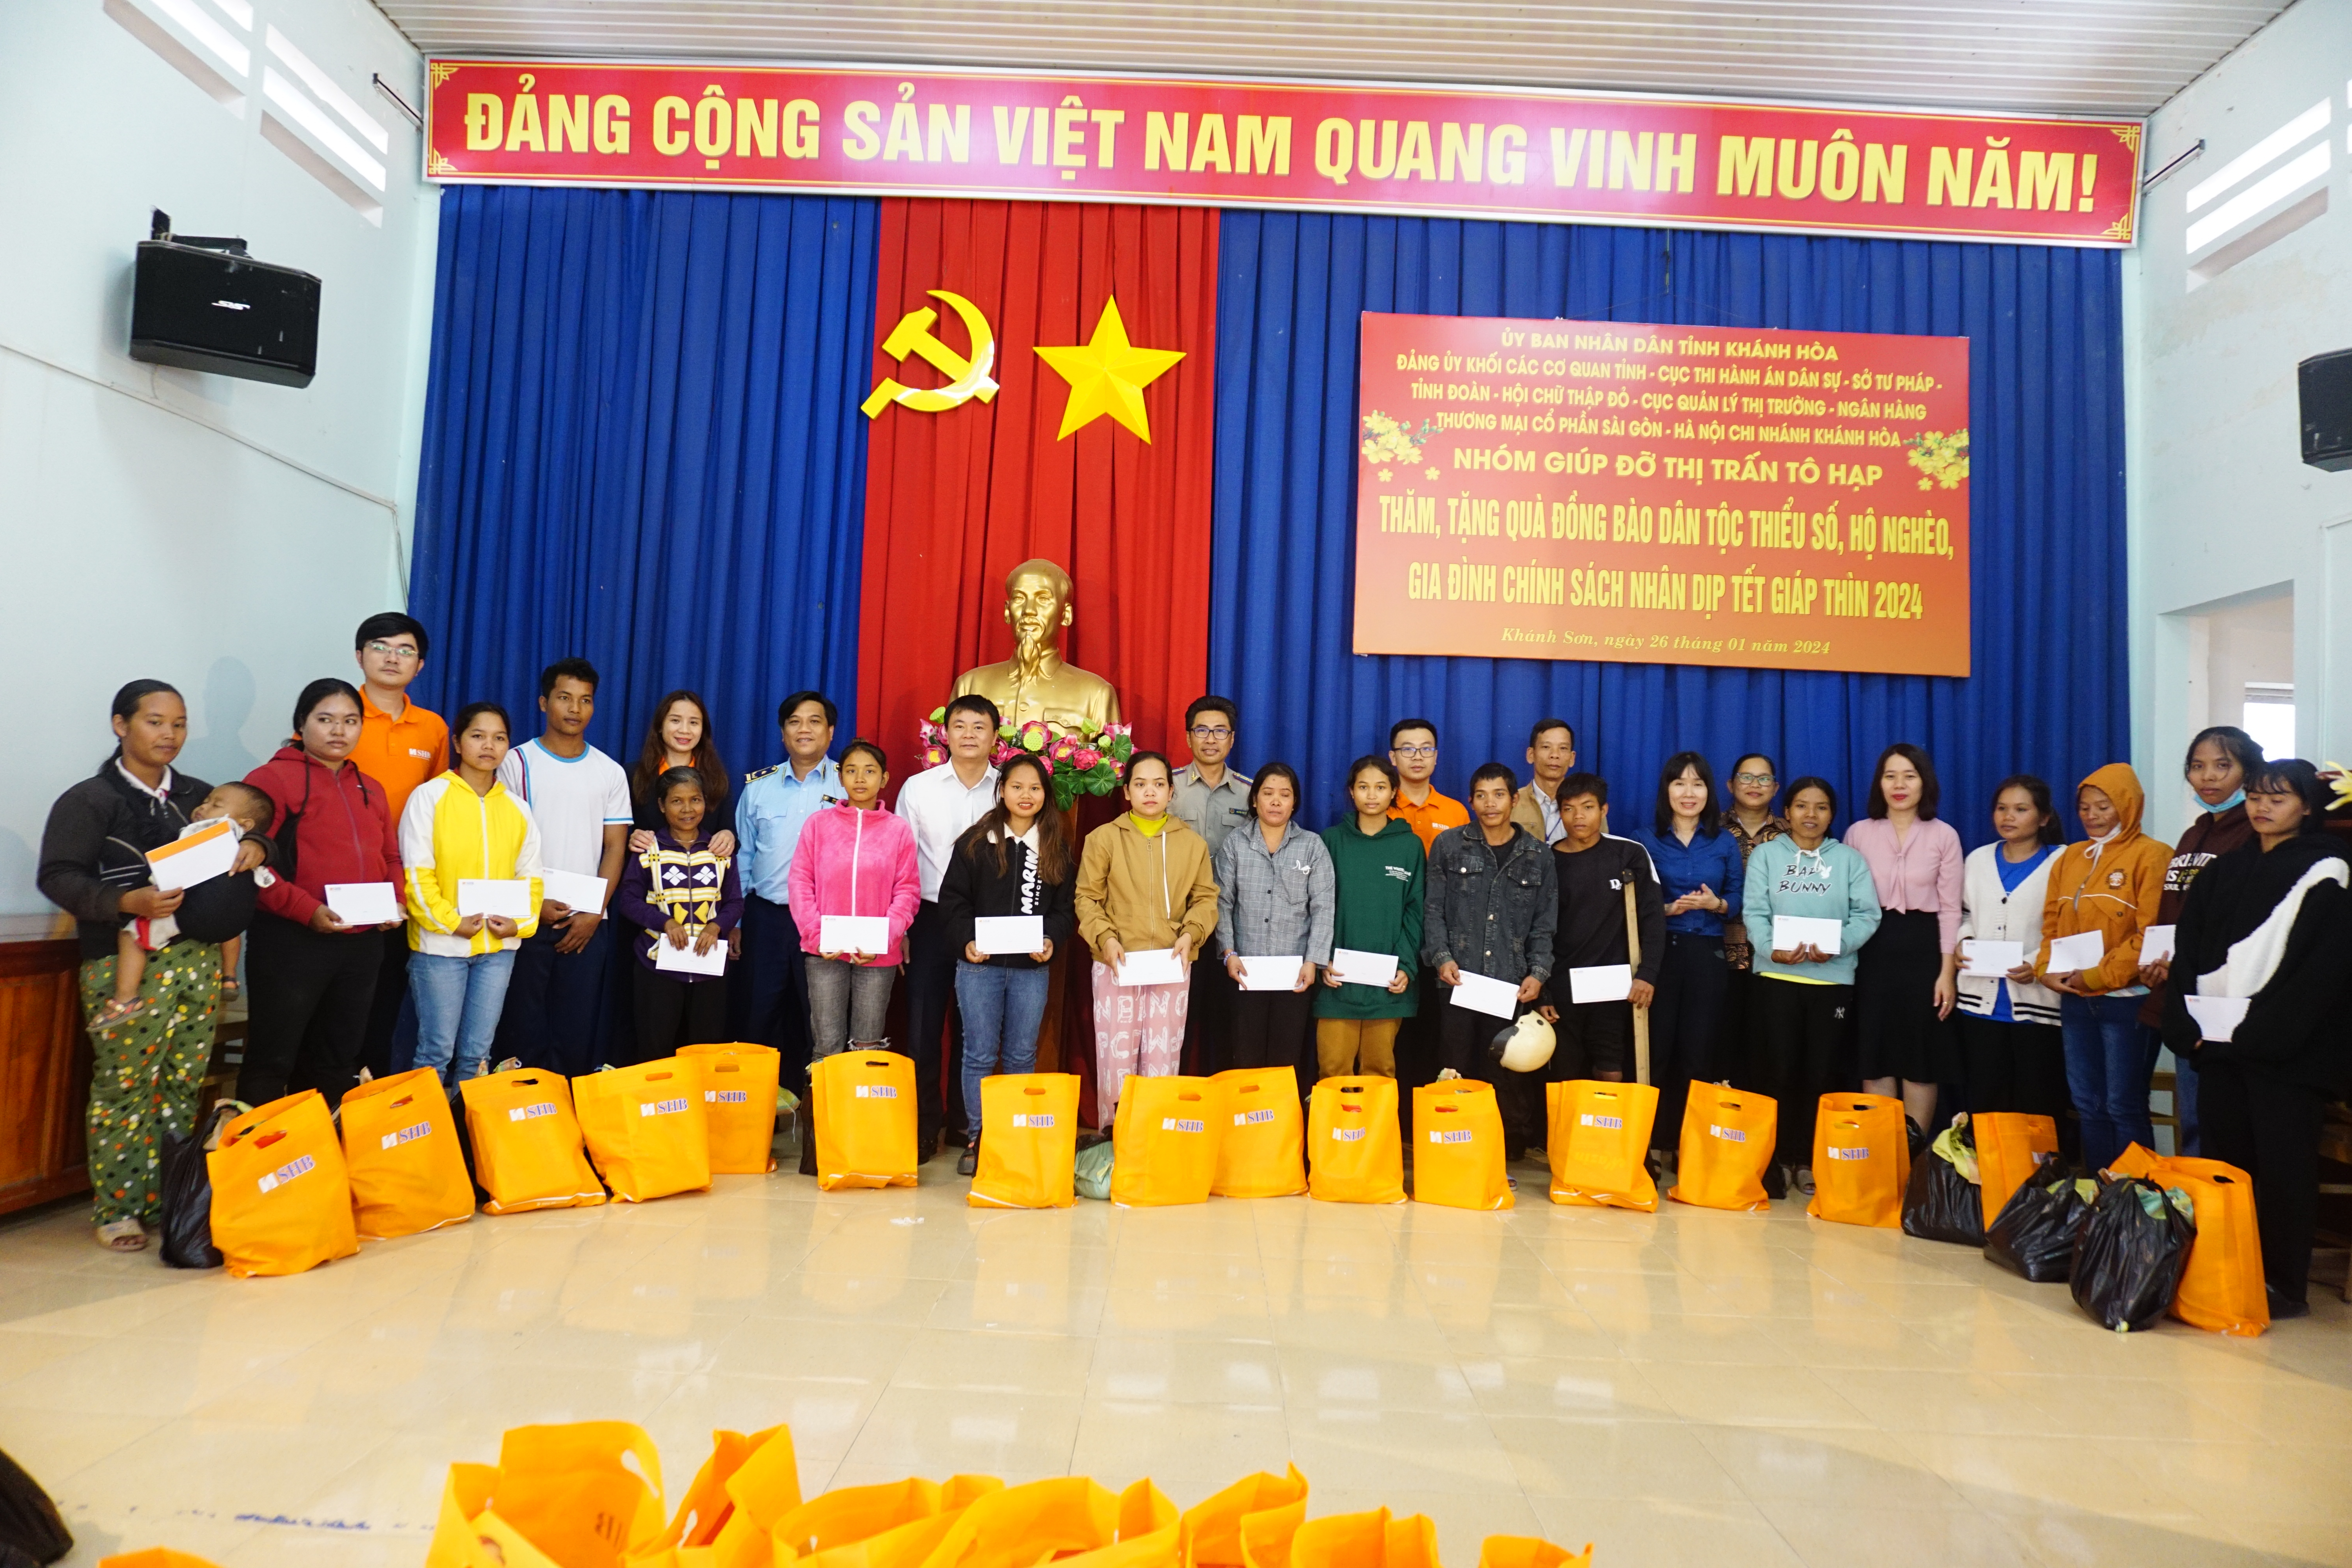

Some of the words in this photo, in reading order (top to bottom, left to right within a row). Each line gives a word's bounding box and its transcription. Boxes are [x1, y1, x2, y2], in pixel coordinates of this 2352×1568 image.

[465, 73, 630, 154] ĐẢNG
[653, 85, 820, 169] CỘNG
[843, 82, 971, 163] SẢN
[994, 96, 1125, 180] VIỆT
[1145, 112, 1292, 175] NAM
[1315, 118, 1527, 184] QUANG
[1550, 127, 1697, 192] VINH
[1718, 128, 1907, 204] MUÔN
[1927, 136, 2097, 212] NĂM!
[1502, 327, 1525, 347] ỦY
[1532, 333, 1568, 349] BAN
[1575, 332, 1628, 352] NHÂN
[1634, 334, 1673, 354] DÂN
[1679, 335, 1719, 356] TỈNH
[1726, 339, 1791, 359] KHÁNH
[1797, 341, 1838, 361] HÒA
[1397, 349, 1439, 372] ĐẢNG
[1444, 350, 1461, 371] ỦY
[1467, 352, 1501, 374] KHỐI
[1506, 354, 1539, 374] CÁC
[1543, 357, 1566, 376] CƠ
[1570, 361, 1610, 379] QUAN
[1615, 359, 1646, 380] TỈNH
[1659, 365, 1690, 386] CỤC
[1694, 367, 1715, 383] THI
[1720, 365, 1759, 385] HÀNH
[1765, 365, 1785, 386] ÁN
[1789, 367, 1819, 388] DÂN
[1824, 372, 1842, 393] SỰ
[1853, 368, 1873, 390] SỞ
[1876, 374, 1893, 390] TƯ
[1896, 372, 1934, 392] PHÁP
[1412, 377, 1443, 400] TỈNH
[1448, 380, 1489, 401] ĐOÀN
[1503, 382, 1528, 406] HỘI
[1533, 384, 1564, 405] CHỮ
[1568, 386, 1603, 410] THẬP
[1608, 386, 1630, 407] ĐỎ
[1642, 393, 1673, 414] CỤC
[1678, 390, 1718, 413] QUẢN
[1723, 392, 1739, 413] LÝ
[1742, 397, 1763, 417] THỊ
[1767, 395, 1826, 416] TRƯỜNG
[1838, 398, 1880, 419] NGÂN
[1885, 399, 1927, 420] HÀNG
[1437, 412, 1497, 430] THƯƠNG
[1501, 416, 1528, 436] MẠI
[1532, 408, 1555, 433] CỔ
[1559, 410, 1597, 435] PHẦN
[1602, 415, 1625, 436] SÀI
[1629, 418, 1662, 437] GÒN
[1675, 419, 1695, 439] HÀ
[1699, 420, 1725, 445] NỘI
[1730, 424, 1755, 441] CHI
[1759, 423, 1810, 444] NHÁNH
[1814, 424, 1864, 446] KHÁNH
[1869, 426, 1901, 448] HÒA
[1454, 444, 1535, 472] NHÓM
[1544, 447, 1608, 474] GIÚP
[1616, 452, 1656, 477] ĐỠ
[1664, 456, 1703, 486] THỊ
[1711, 451, 1778, 483] TRẤN
[1786, 456, 1820, 484] TÔ
[1829, 463, 1883, 491] HẠP
[1379, 488, 1441, 539] THĂM,
[1448, 490, 1500, 544] TẶNG
[1506, 493, 1546, 541] QUÀ
[1552, 490, 1606, 541] ĐỒNG
[1613, 497, 1652, 543] BÀO
[1659, 499, 1700, 545] DÂN
[1707, 501, 1743, 555] TỘC
[1750, 496, 1806, 549] THIỂU
[1812, 500, 1844, 555] SỐ,
[1850, 507, 1877, 560] HỘ
[1883, 510, 1954, 560] NGHÈO,
[1409, 562, 1441, 600] GIA
[1448, 556, 1496, 602] ĐÌNH
[1503, 559, 1564, 605] CHÍNH
[1570, 561, 1623, 608] SÁCH
[1630, 564, 1686, 610] NHÂN
[1693, 573, 1725, 620] DỊP
[1732, 564, 1766, 613] TẾT
[1771, 570, 1818, 615] GIÁP
[1824, 572, 1869, 617] THÌN
[1875, 581, 1923, 619] 2024
[1501, 628, 1557, 644] Khánh
[1563, 630, 1598, 648] Sơn,
[1604, 635, 1644, 649] ngày
[1650, 635, 1668, 647] 26
[1674, 636, 1723, 653] tháng
[1729, 638, 1746, 651] 01
[1752, 639, 1788, 652] năm
[1793, 640, 1830, 654] 2024
[417, 749, 431, 759] SHB
[1775, 880, 1832, 896] BUNNY
[718, 1090, 747, 1103] SHB
[871, 1085, 897, 1099] SHB
[526, 1103, 557, 1118] SHB
[657, 1098, 688, 1114] SHB
[1028, 1114, 1055, 1128] SHB
[1247, 1109, 1275, 1124] SHB
[1594, 1115, 1623, 1129] SHB
[399, 1120, 432, 1143] SHB
[1176, 1119, 1204, 1132] SHB
[1342, 1127, 1366, 1142] SHB
[1443, 1129, 1473, 1143] SHB
[1721, 1127, 1746, 1143] SHB
[1841, 1147, 1870, 1161] SHB
[276, 1154, 316, 1185] SHB
